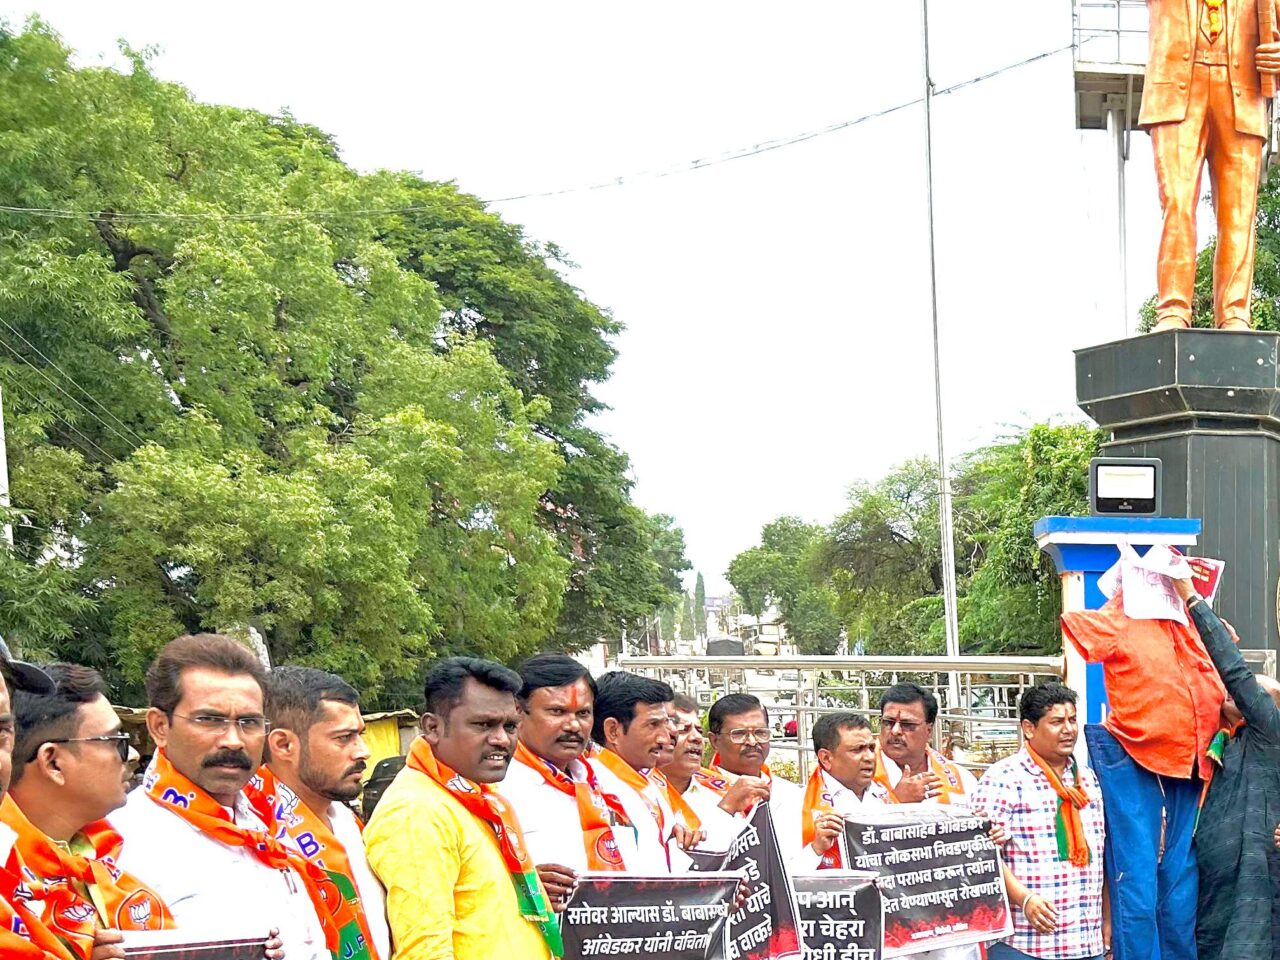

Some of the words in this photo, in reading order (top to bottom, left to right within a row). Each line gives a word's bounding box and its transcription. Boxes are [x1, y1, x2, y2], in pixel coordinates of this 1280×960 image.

[861, 826, 879, 845] डॉ.
[880, 818, 936, 840] बाबासाहेब
[855, 852, 883, 869] यांचा
[884, 845, 933, 865] लोकसभा
[896, 869, 932, 888] पराभव
[965, 858, 996, 876] त्यांना
[567, 902, 608, 925] सत्तेवर
[610, 904, 659, 924] आल्यास
[661, 900, 680, 923] डॉ.
[901, 889, 959, 910] येण्यापासून
[820, 913, 865, 940] चेहरा
[581, 932, 643, 956] आंबेडकर
[643, 930, 673, 954] यांनी
